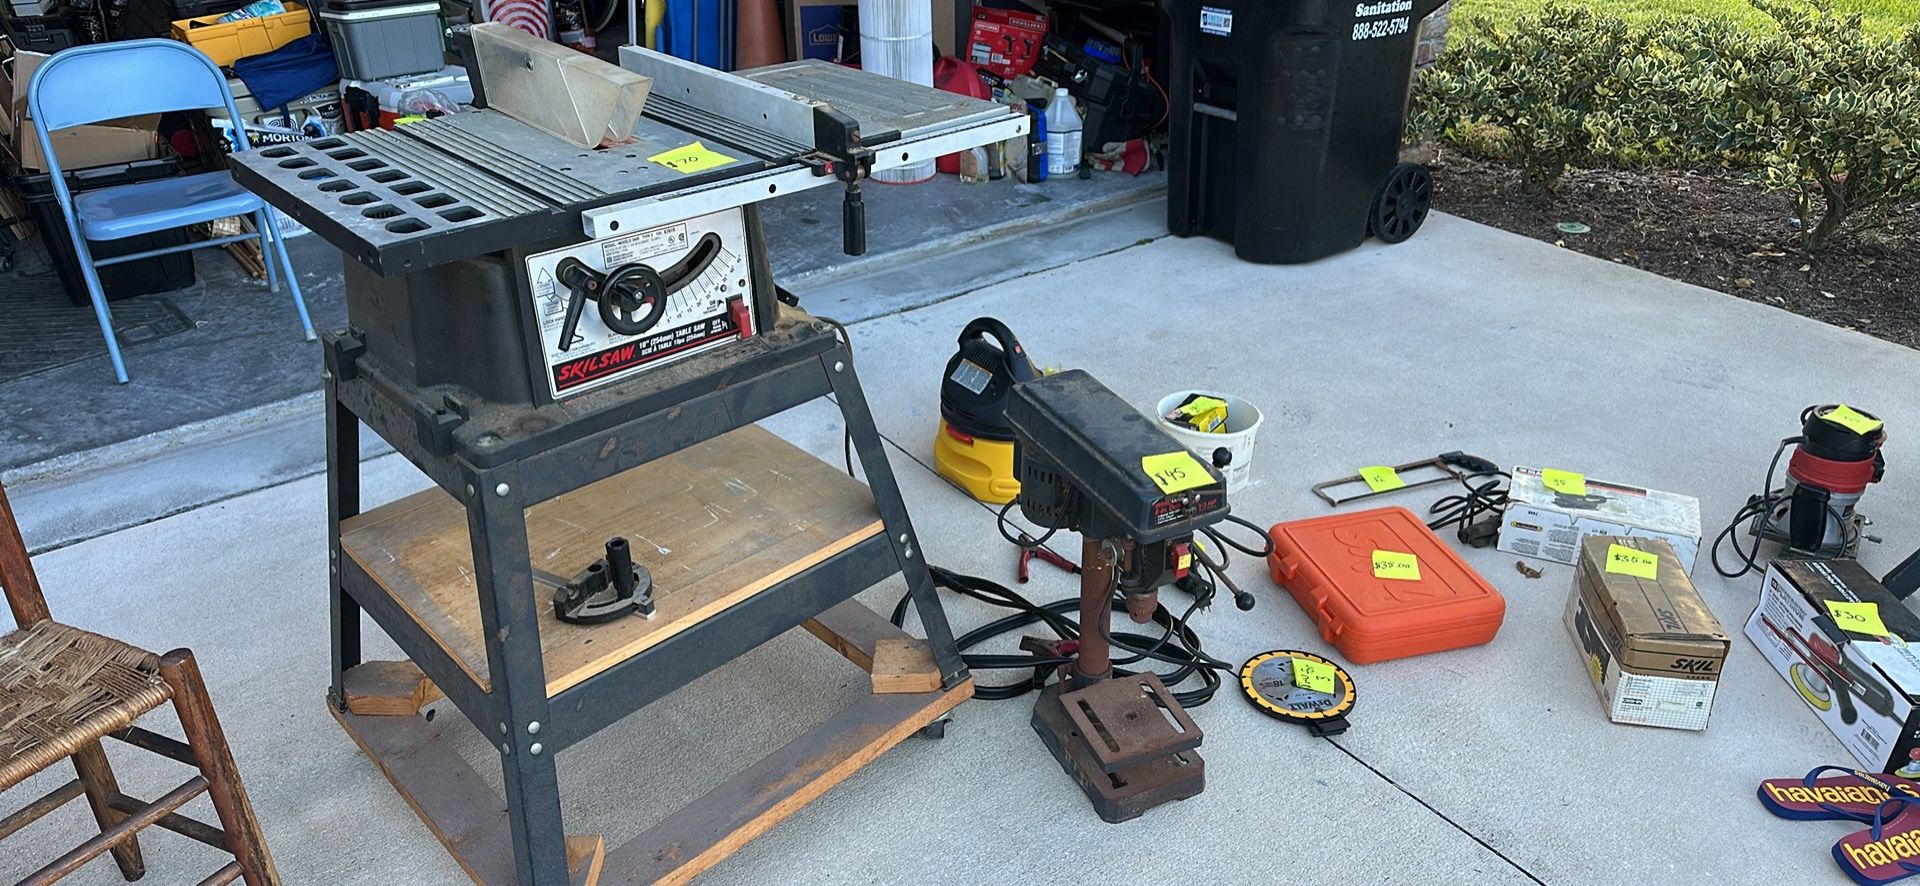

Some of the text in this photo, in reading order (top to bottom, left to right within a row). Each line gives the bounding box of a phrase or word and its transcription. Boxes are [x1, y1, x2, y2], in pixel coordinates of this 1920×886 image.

[1355, 0, 1413, 17] Sanitation
[1352, 16, 1410, 40] 888-522-5794
[262, 133, 313, 143] MORTON
[675, 327, 692, 339] TABLE
[693, 322, 706, 335] SAW
[558, 344, 636, 379] SKILSAW
[1155, 467, 1186, 486] $45
[1658, 608, 1682, 630] SKIL
[1670, 658, 1715, 674] SKIL
